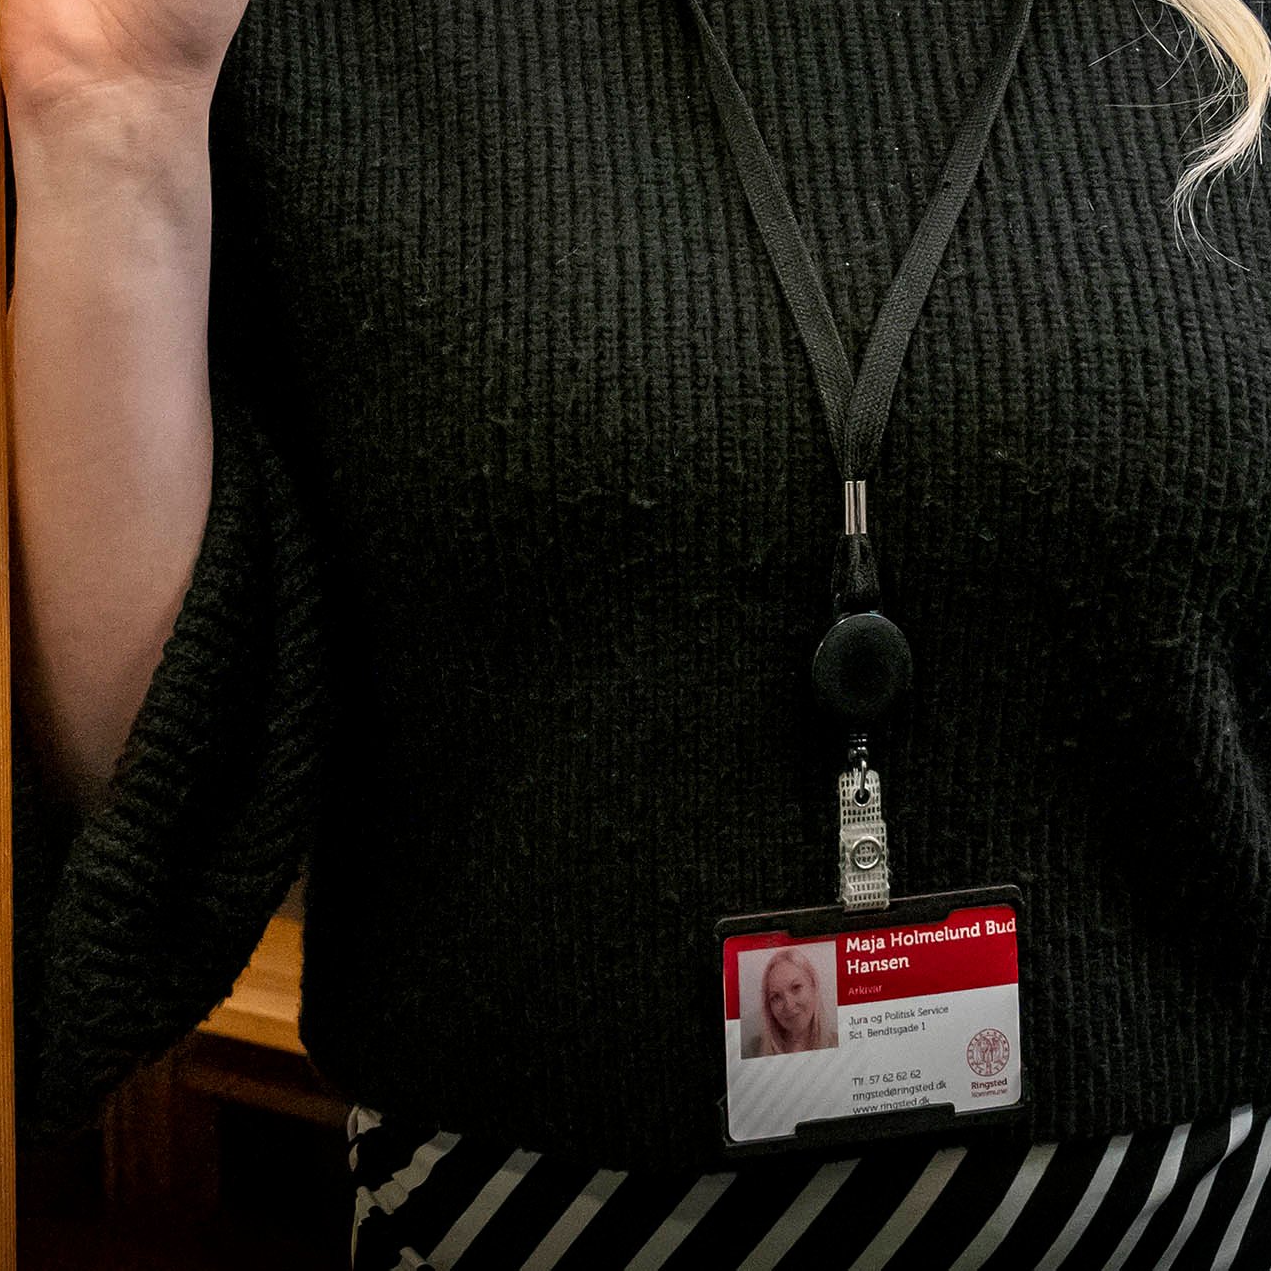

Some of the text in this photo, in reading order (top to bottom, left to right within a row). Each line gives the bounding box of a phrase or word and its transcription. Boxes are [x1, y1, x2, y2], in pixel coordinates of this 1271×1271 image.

[846, 917, 1017, 954] Maja Holmelund Bud
[846, 956, 910, 975] Hansen
[848, 1006, 949, 1026] Jura og Politisk Service
[867, 1023, 919, 1038] Bendtsgade
[869, 1075, 880, 1085] 57
[882, 1073, 894, 1083] 62
[896, 1071, 908, 1081] 62
[910, 1069, 922, 1079] 62
[970, 1078, 1008, 1090] Ringsted
